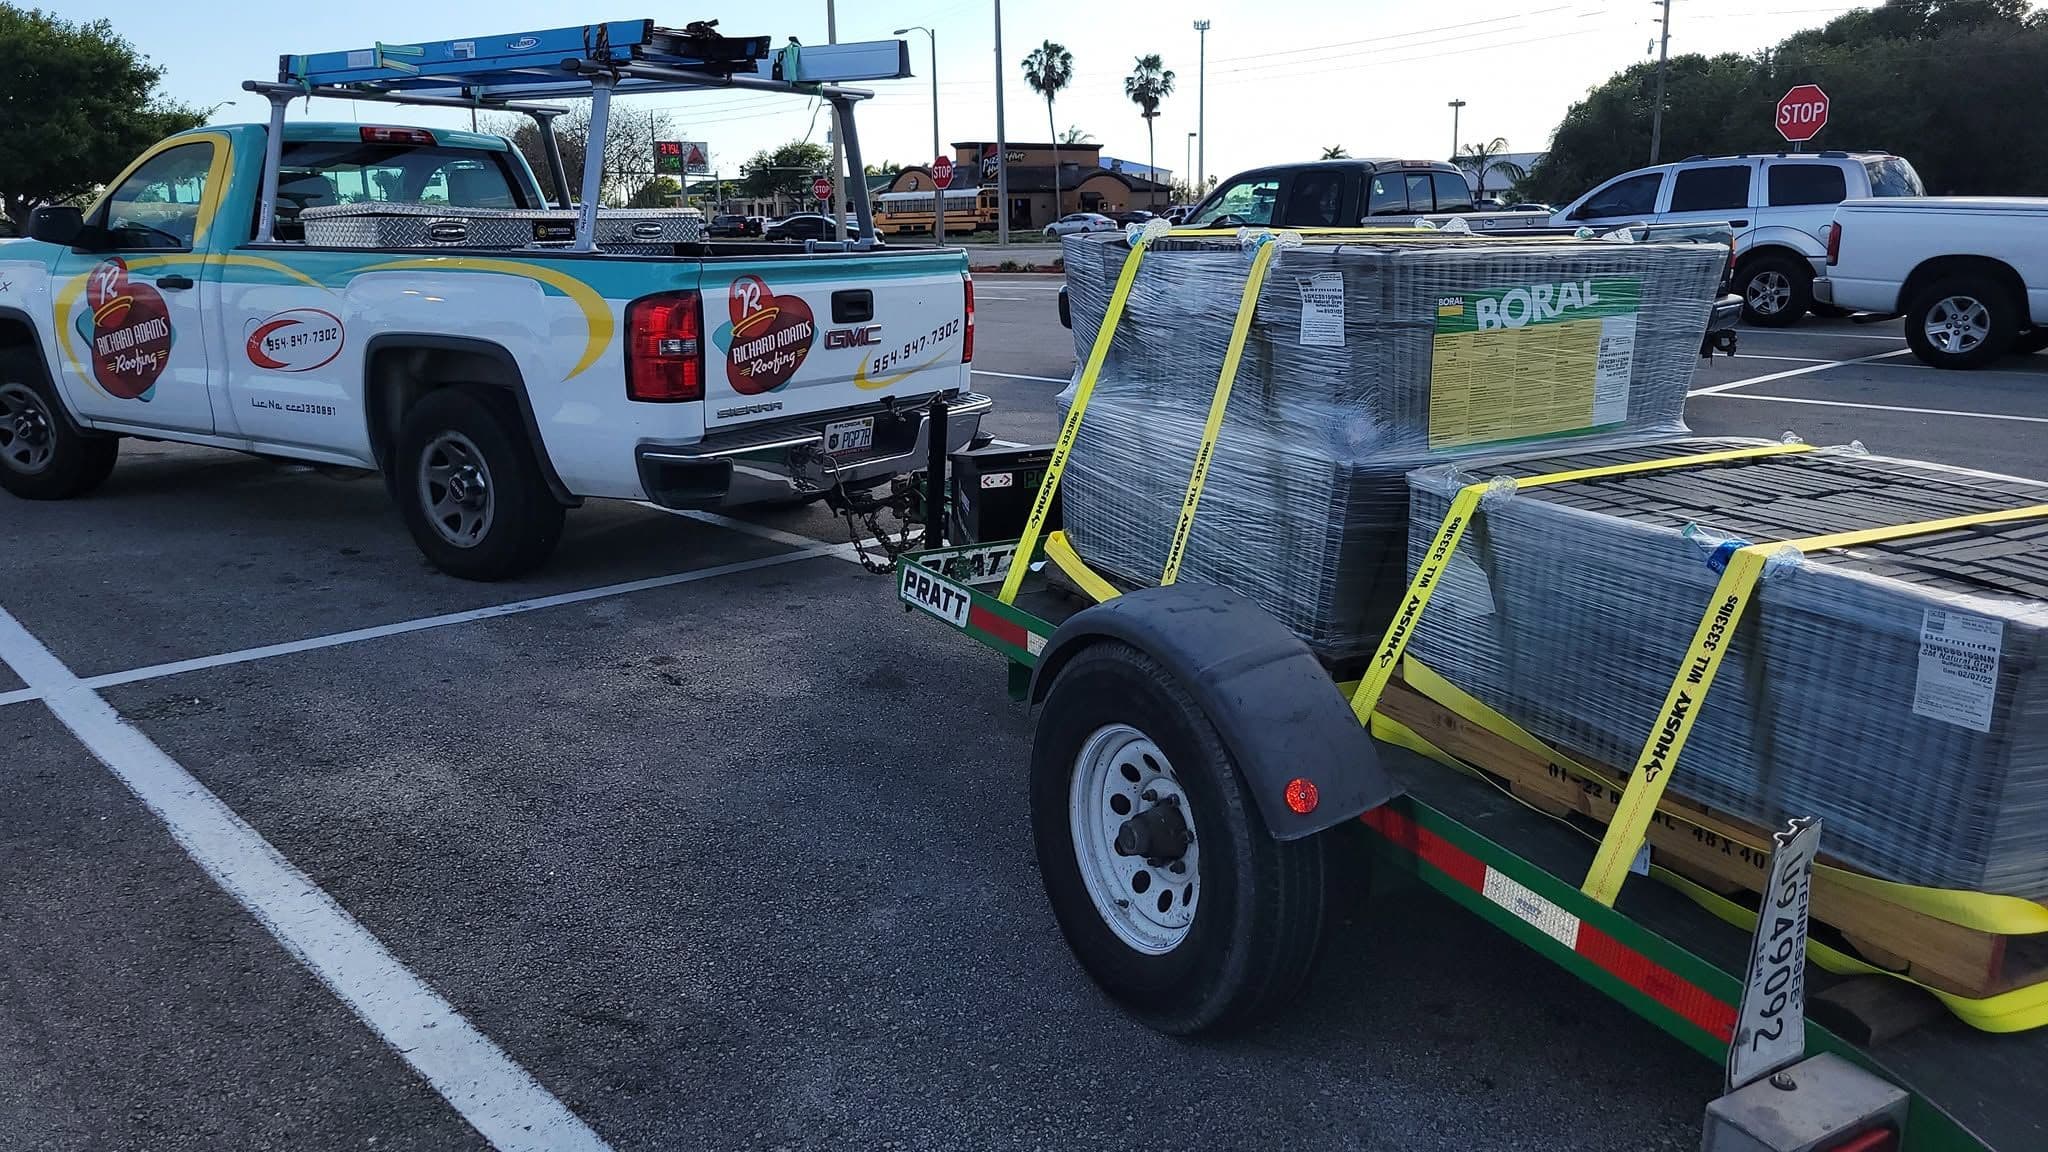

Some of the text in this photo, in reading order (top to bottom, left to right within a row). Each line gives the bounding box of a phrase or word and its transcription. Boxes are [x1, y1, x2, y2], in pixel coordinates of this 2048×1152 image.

[1780, 102, 1825, 124] STOP
[933, 165, 952, 179] STOP
[814, 185, 830, 194] STOP
[1438, 296, 1464, 306] BORAL
[1475, 280, 1600, 332] BORAL
[96, 317, 168, 356] RICHARD ADAMS
[733, 320, 812, 365] RICHARD ADAMS
[824, 324, 882, 350] GMC
[115, 349, 157, 375] Roofing
[750, 351, 796, 376] Roofing
[717, 400, 783, 419] SIERRA
[1037, 411, 1080, 515] HUSKY WLL 3333lbs
[1171, 441, 1211, 562] HUSKY WLL 3333lbs
[903, 569, 967, 621] PRATT
[1388, 516, 1462, 650] HUSKY WLL 3333lbs
[1939, 651, 1971, 665] Natural
[1973, 659, 1994, 671] Gray
[1652, 595, 1738, 760] HUSKY WLL 3333lbs
[1789, 879, 1809, 1004] TENNESSEE
